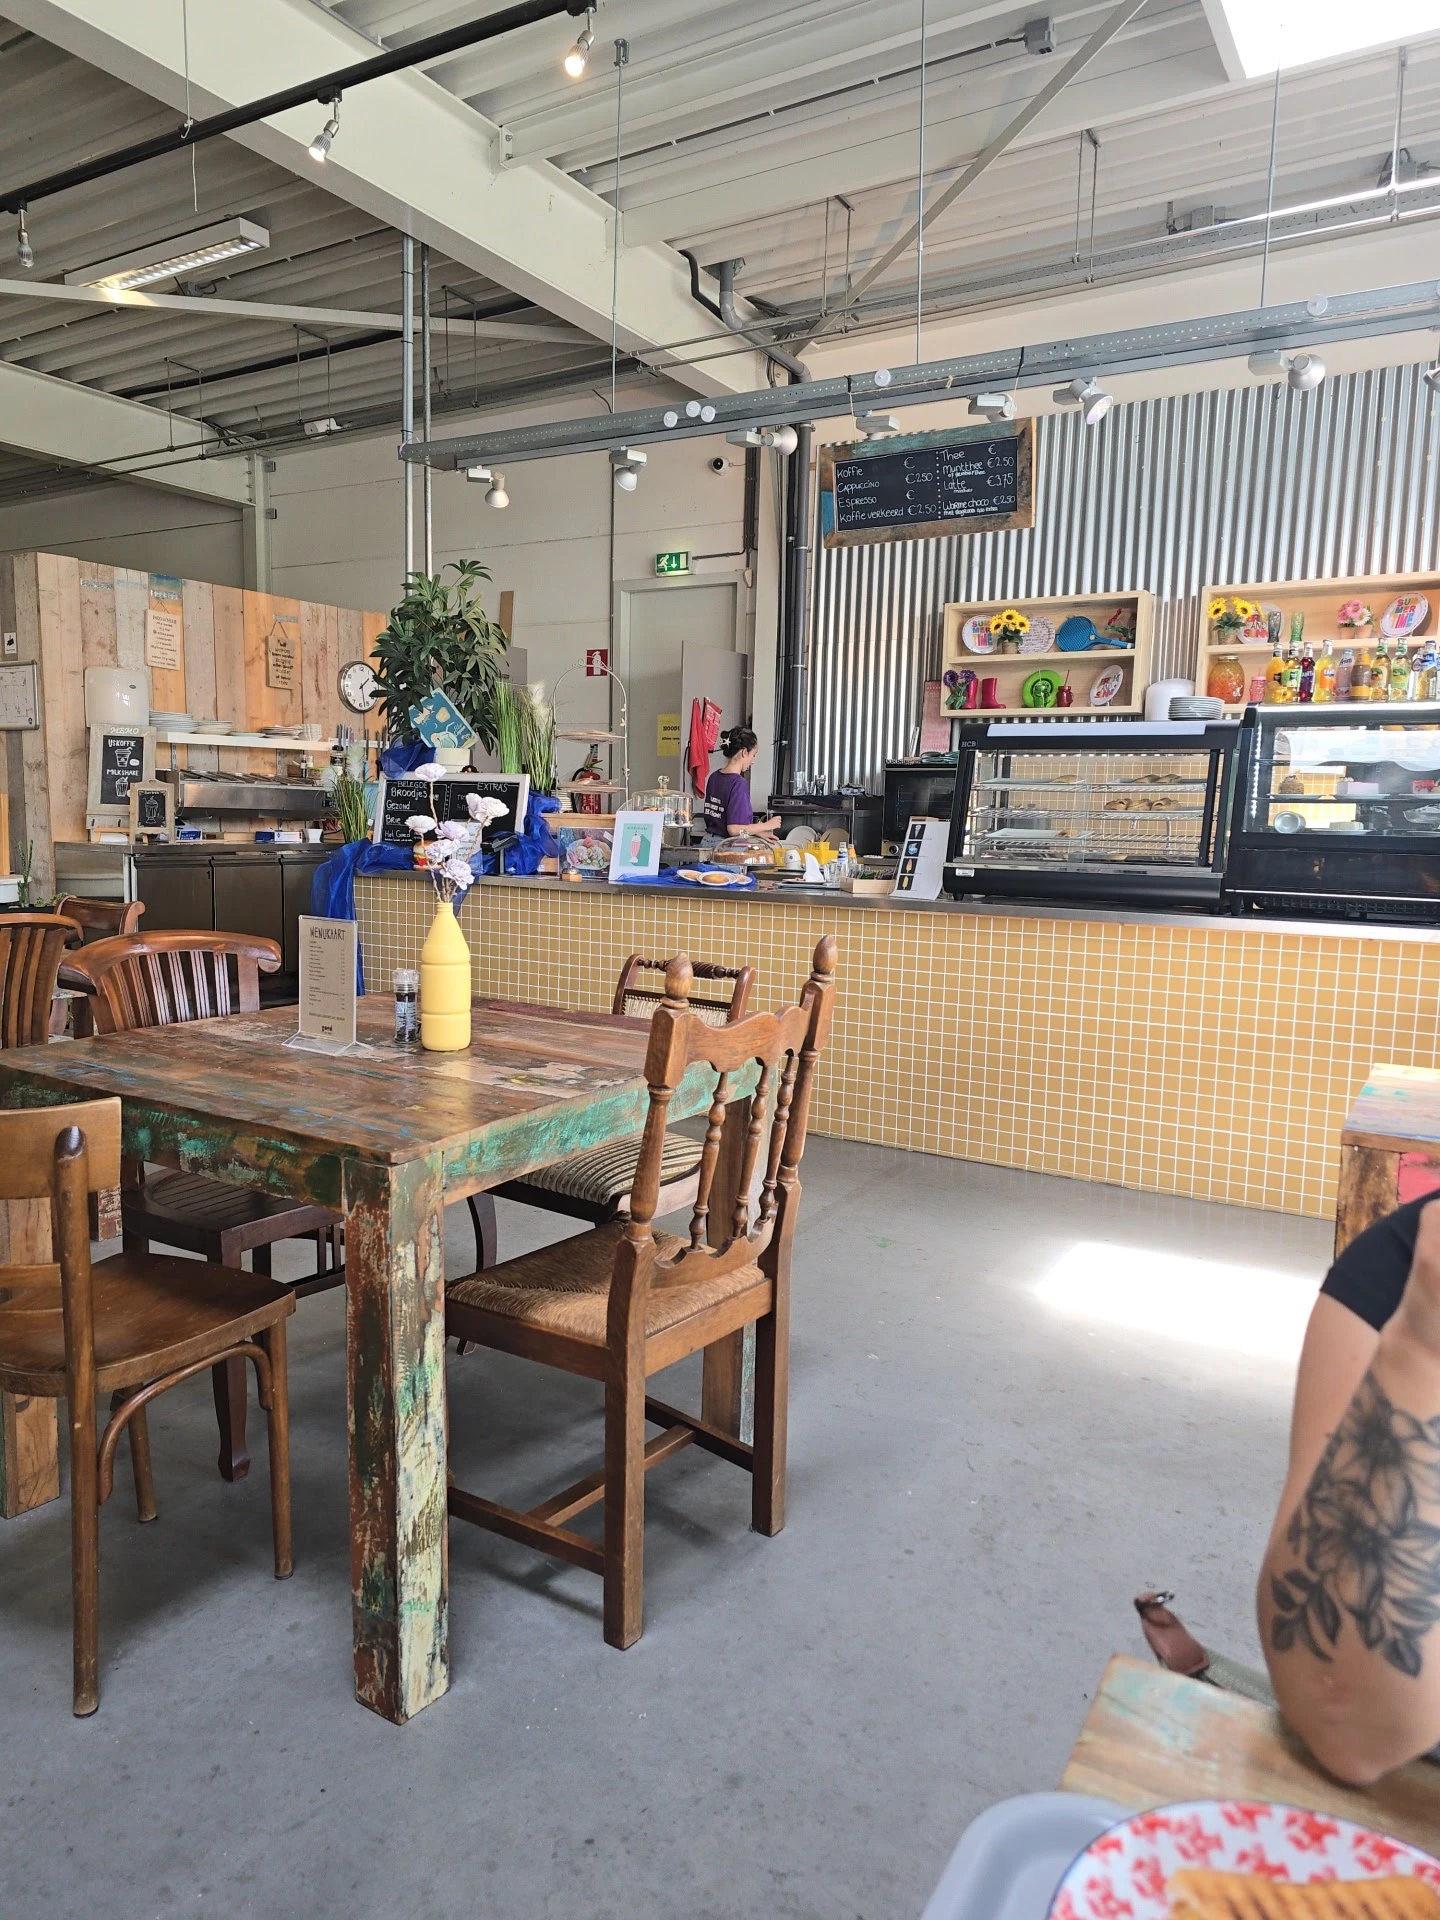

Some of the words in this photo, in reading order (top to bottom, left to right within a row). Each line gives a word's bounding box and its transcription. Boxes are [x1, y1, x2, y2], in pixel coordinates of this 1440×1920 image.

[940, 449, 966, 462] Thee
[837, 466, 864, 478] Koffie
[942, 460, 983, 475] Muntthee
[837, 480, 880, 494] Cappuccino
[944, 478, 967, 490] Latte
[838, 496, 877, 510] Espresso
[942, 501, 968, 511] Warme
[968, 498, 989, 507] choco
[840, 510, 866, 524] Koffie
[868, 507, 904, 520] verkeerd
[398, 781, 427, 789] BELEGDE
[390, 788, 428, 800] Broodjes
[386, 800, 410, 810] Gezond
[385, 814, 401, 824] Brie
[310, 926, 346, 941] MENUKAART
